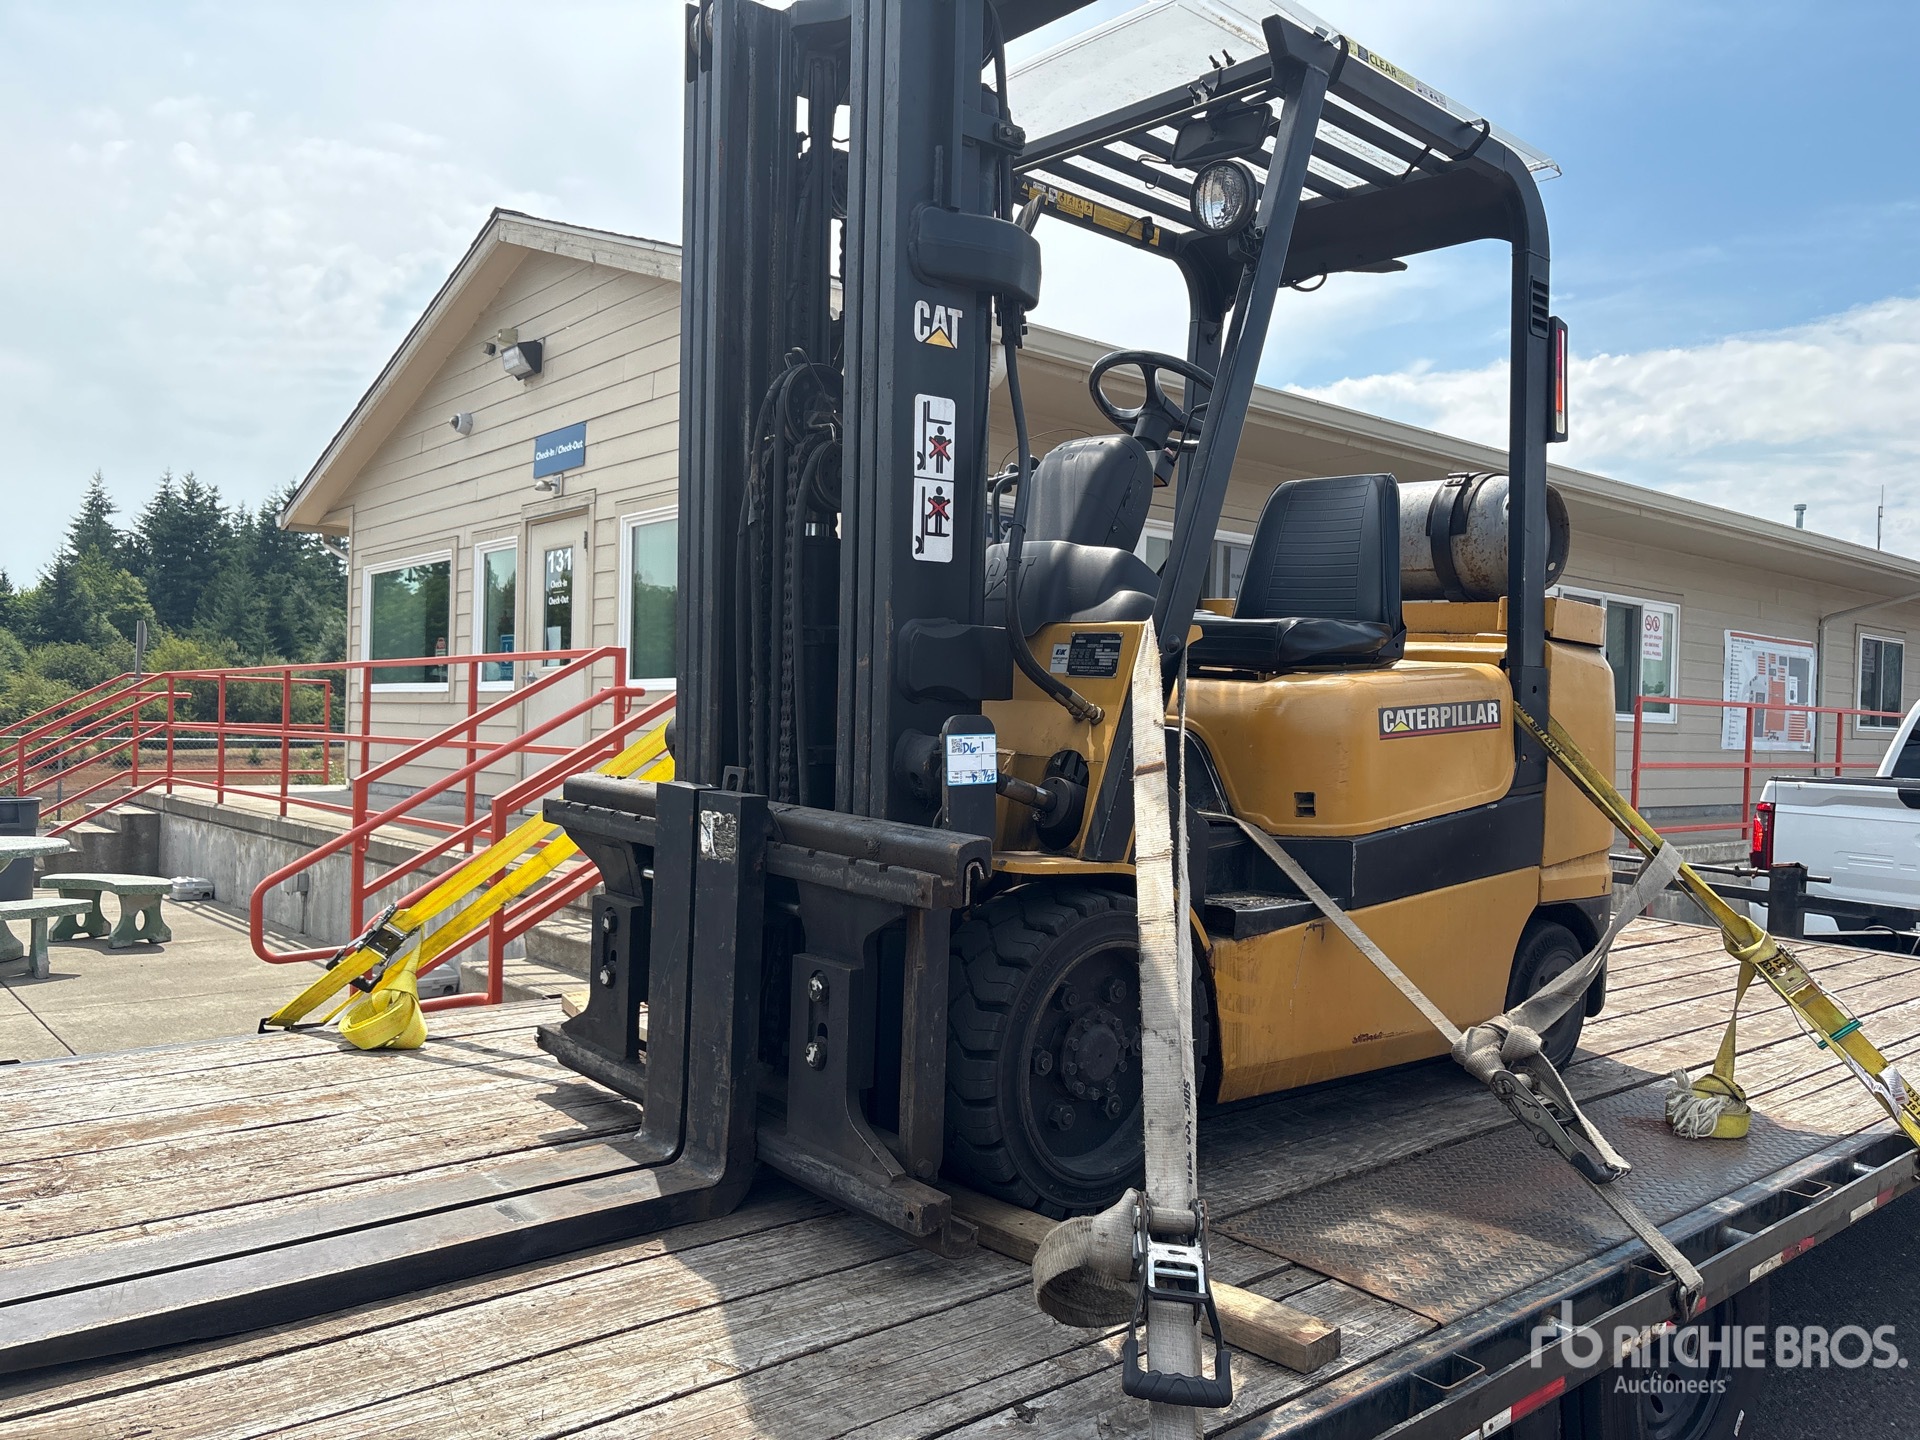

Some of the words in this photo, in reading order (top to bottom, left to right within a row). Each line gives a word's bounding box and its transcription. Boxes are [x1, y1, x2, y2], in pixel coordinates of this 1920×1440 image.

[1370, 54, 1397, 78] CLEAR
[914, 300, 963, 349] CAT
[535, 448, 554, 461] Check-In
[558, 440, 583, 454] Check-Out
[548, 548, 571, 574] 131
[550, 578, 568, 588] Check-In
[548, 595, 569, 606] Check-Out
[1383, 703, 1499, 733] CATERPILLAR
